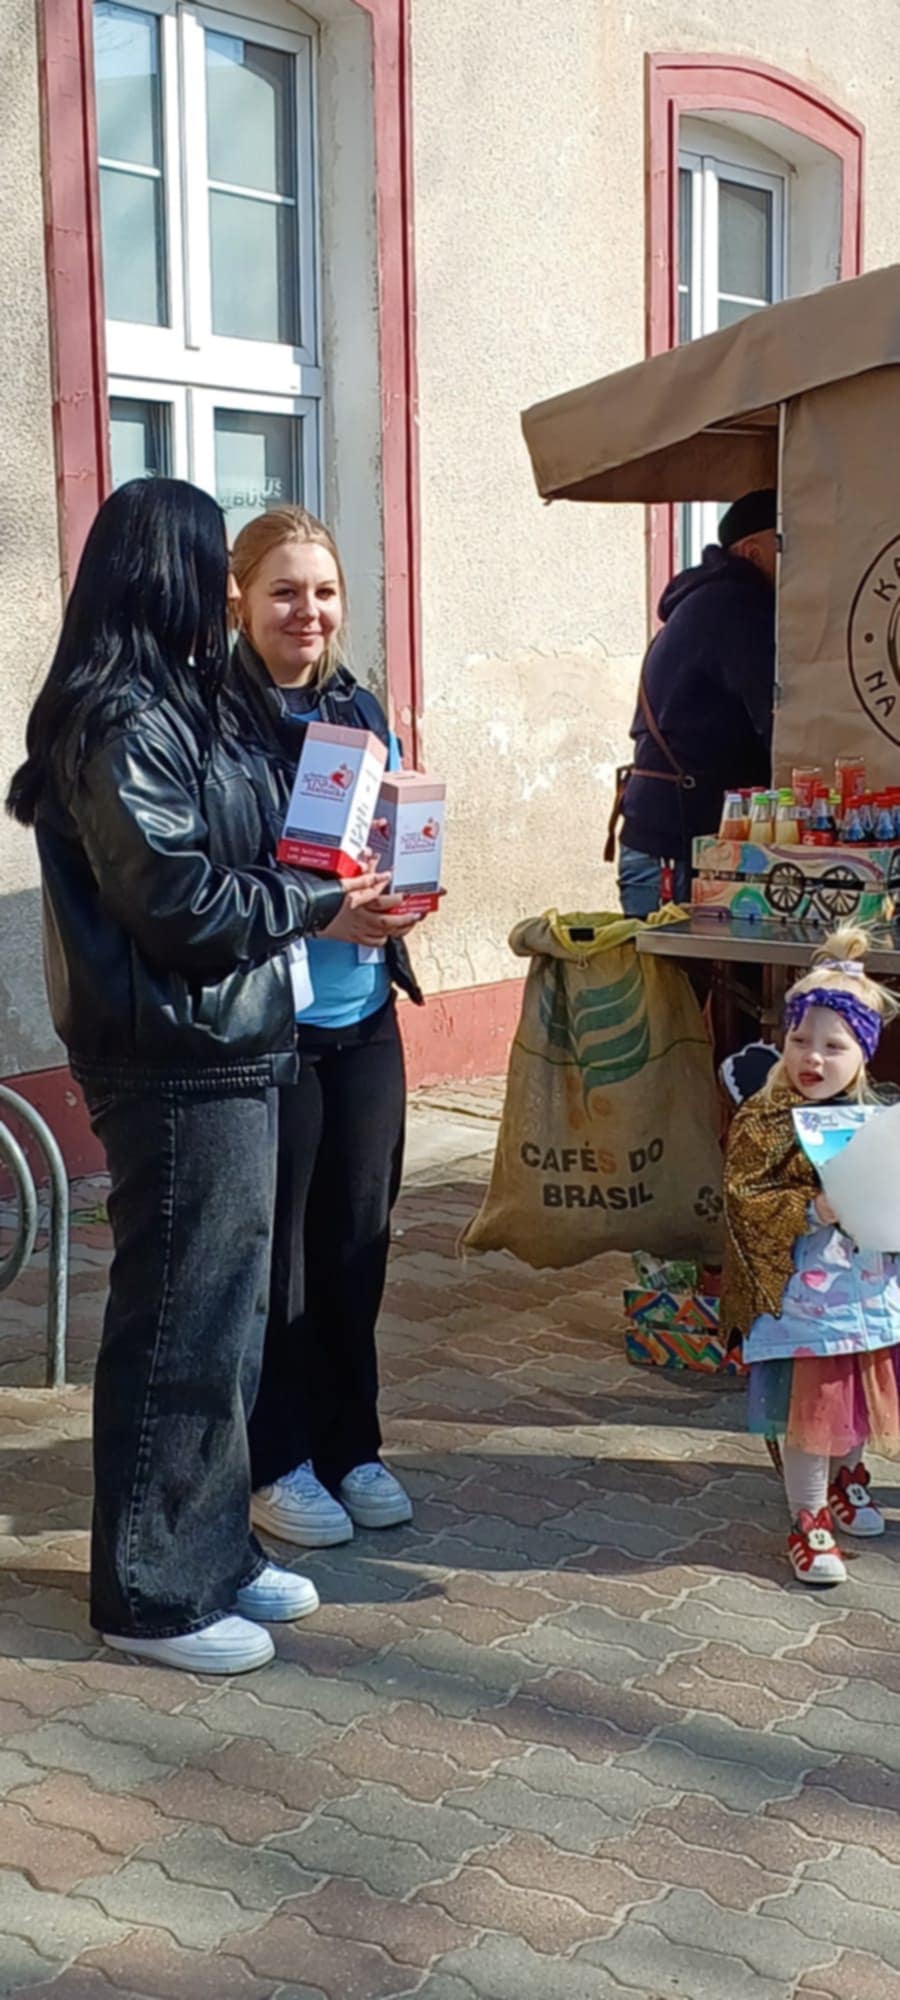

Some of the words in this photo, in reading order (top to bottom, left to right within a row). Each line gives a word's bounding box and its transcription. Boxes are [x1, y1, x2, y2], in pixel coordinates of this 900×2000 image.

[520, 1140, 618, 1175] CAFÉS
[628, 1137, 664, 1173] DO
[542, 1182, 654, 1210] BRASIL
